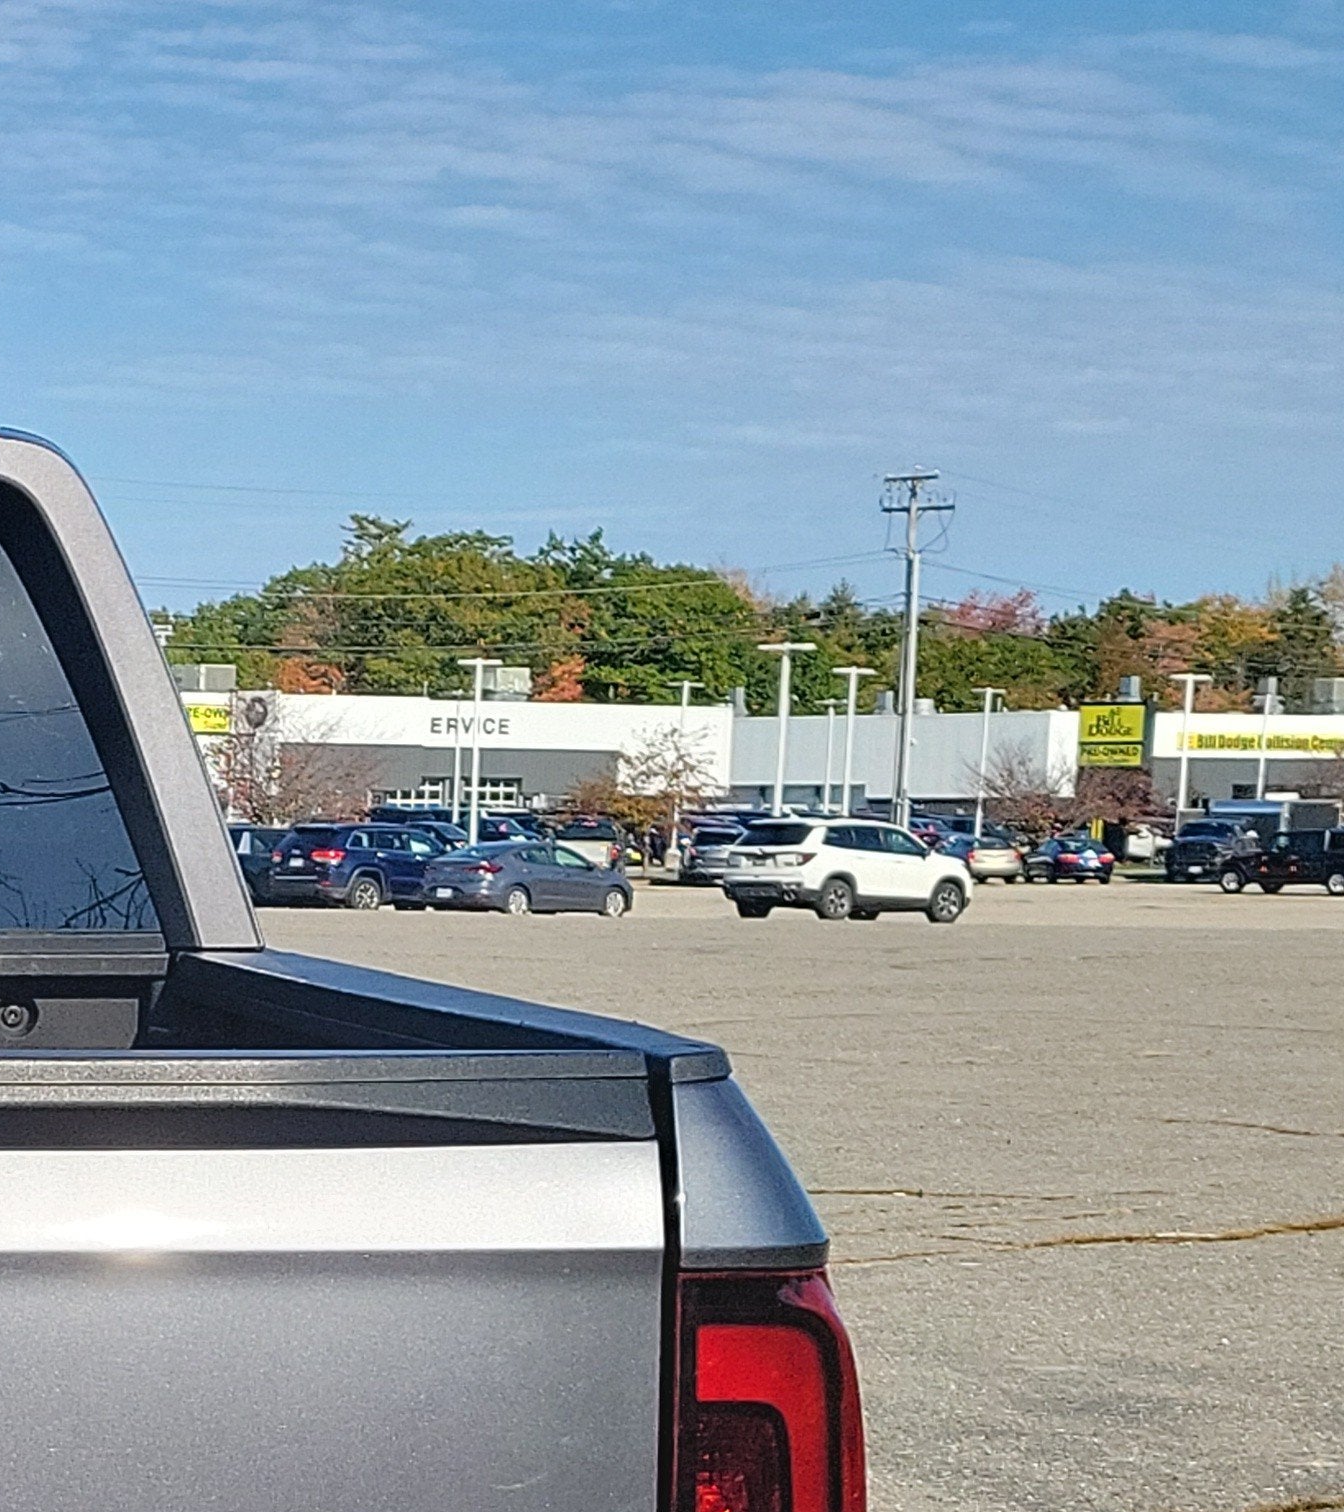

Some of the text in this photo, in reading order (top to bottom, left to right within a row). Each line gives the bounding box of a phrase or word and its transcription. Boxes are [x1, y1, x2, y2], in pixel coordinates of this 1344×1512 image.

[430, 717, 510, 735] ERVICE
[1197, 733, 1217, 749] Bill
[1218, 734, 1255, 750] Dodge
